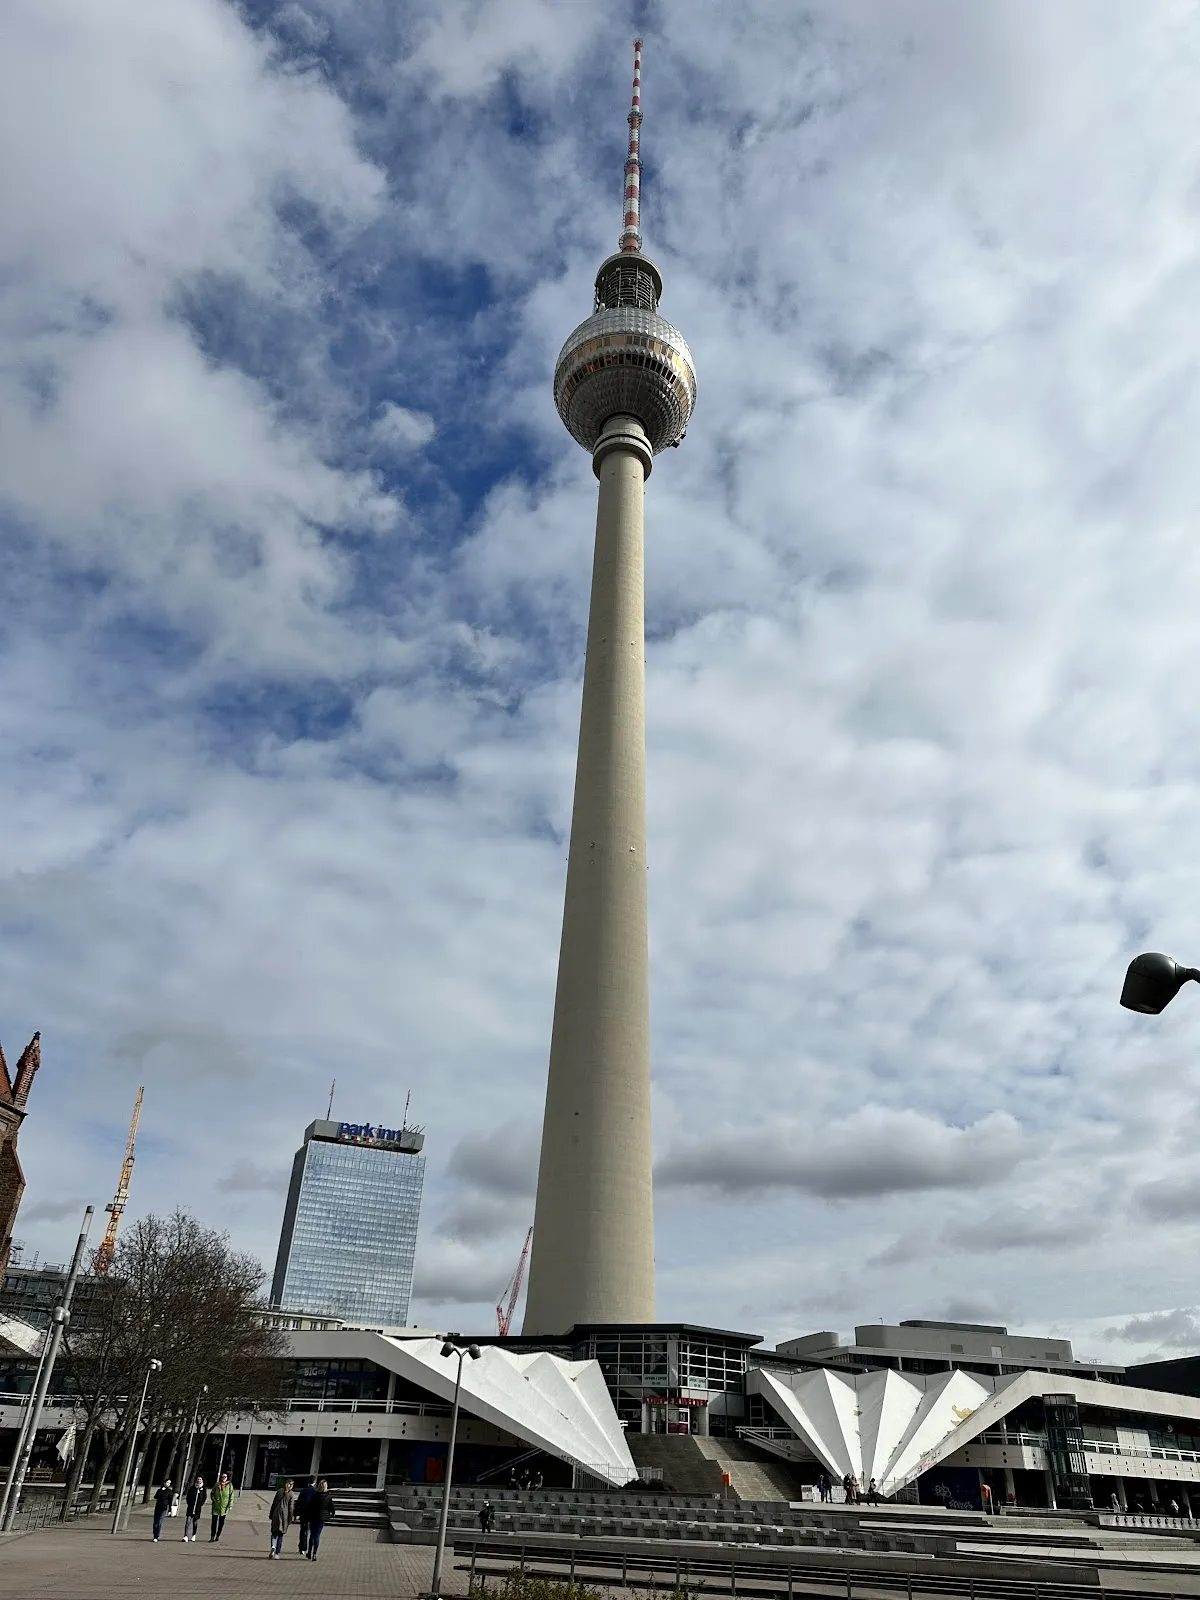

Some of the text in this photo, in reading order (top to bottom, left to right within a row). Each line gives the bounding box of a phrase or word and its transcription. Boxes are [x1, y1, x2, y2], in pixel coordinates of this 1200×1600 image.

[340, 1122, 402, 1142] park inn
[304, 1366, 318, 1377] BIG
